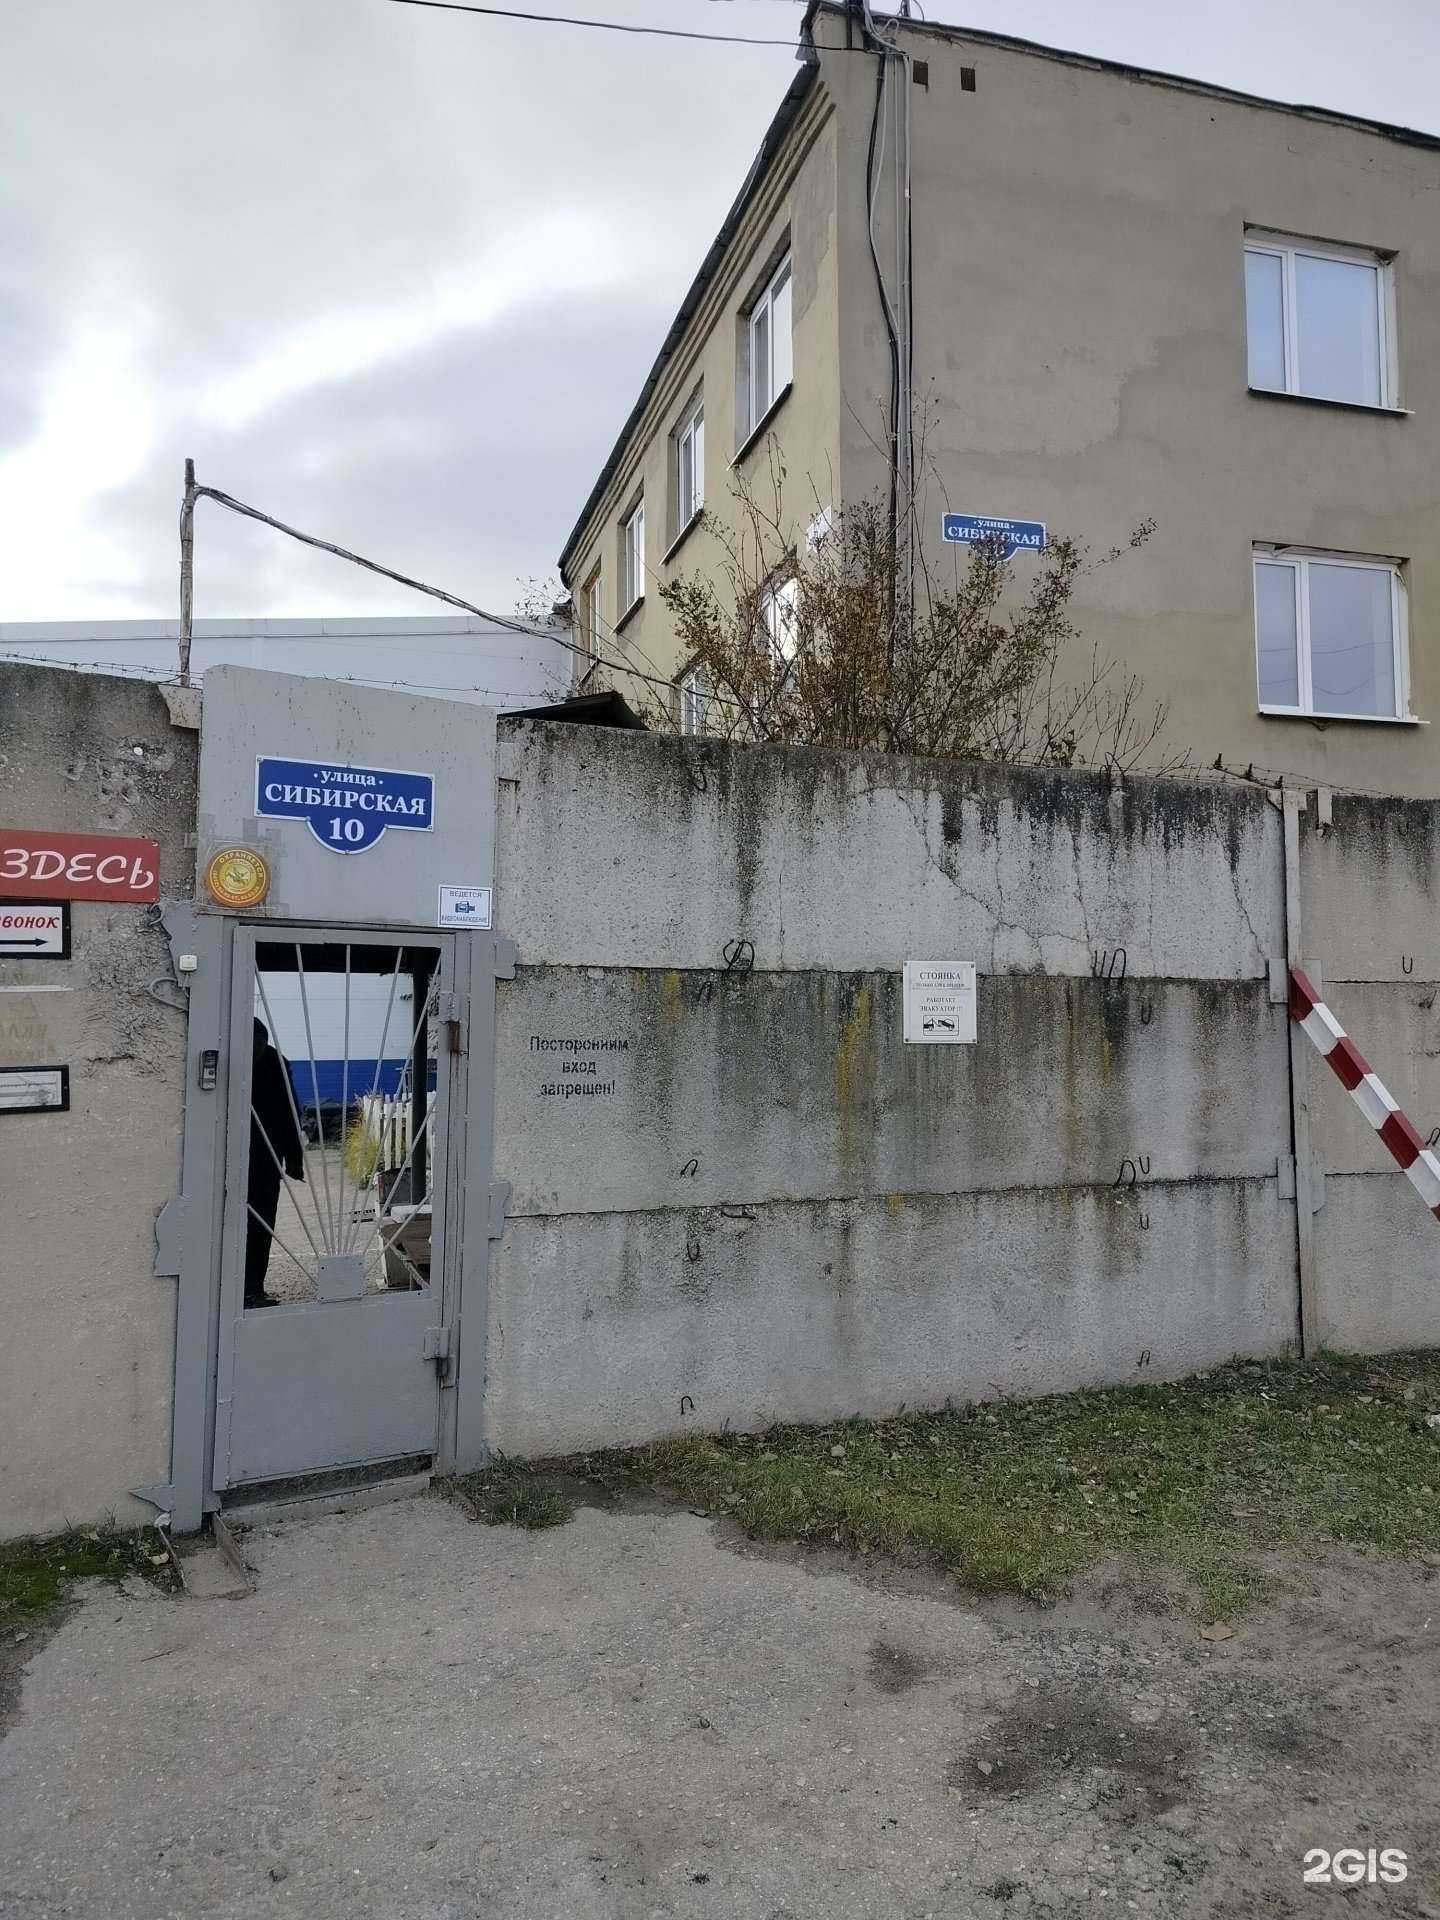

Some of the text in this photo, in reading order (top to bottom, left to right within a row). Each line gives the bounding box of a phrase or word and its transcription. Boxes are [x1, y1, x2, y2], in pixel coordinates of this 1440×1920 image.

[977, 519, 1010, 529] улица
[320, 770, 376, 787] улица
[265, 783, 427, 815] СИБИРСКАЯ
[329, 817, 365, 842] 10
[0, 848, 154, 889] ЗДЕСЬ
[449, 890, 482, 898] ВЕДЕТСЯ
[0, 915, 60, 929] ВОНОК
[919, 971, 961, 980] СТОЯНКА
[530, 1036, 628, 1054] Посторонним
[562, 1061, 596, 1075] вход
[540, 1080, 615, 1099] запрещен!
